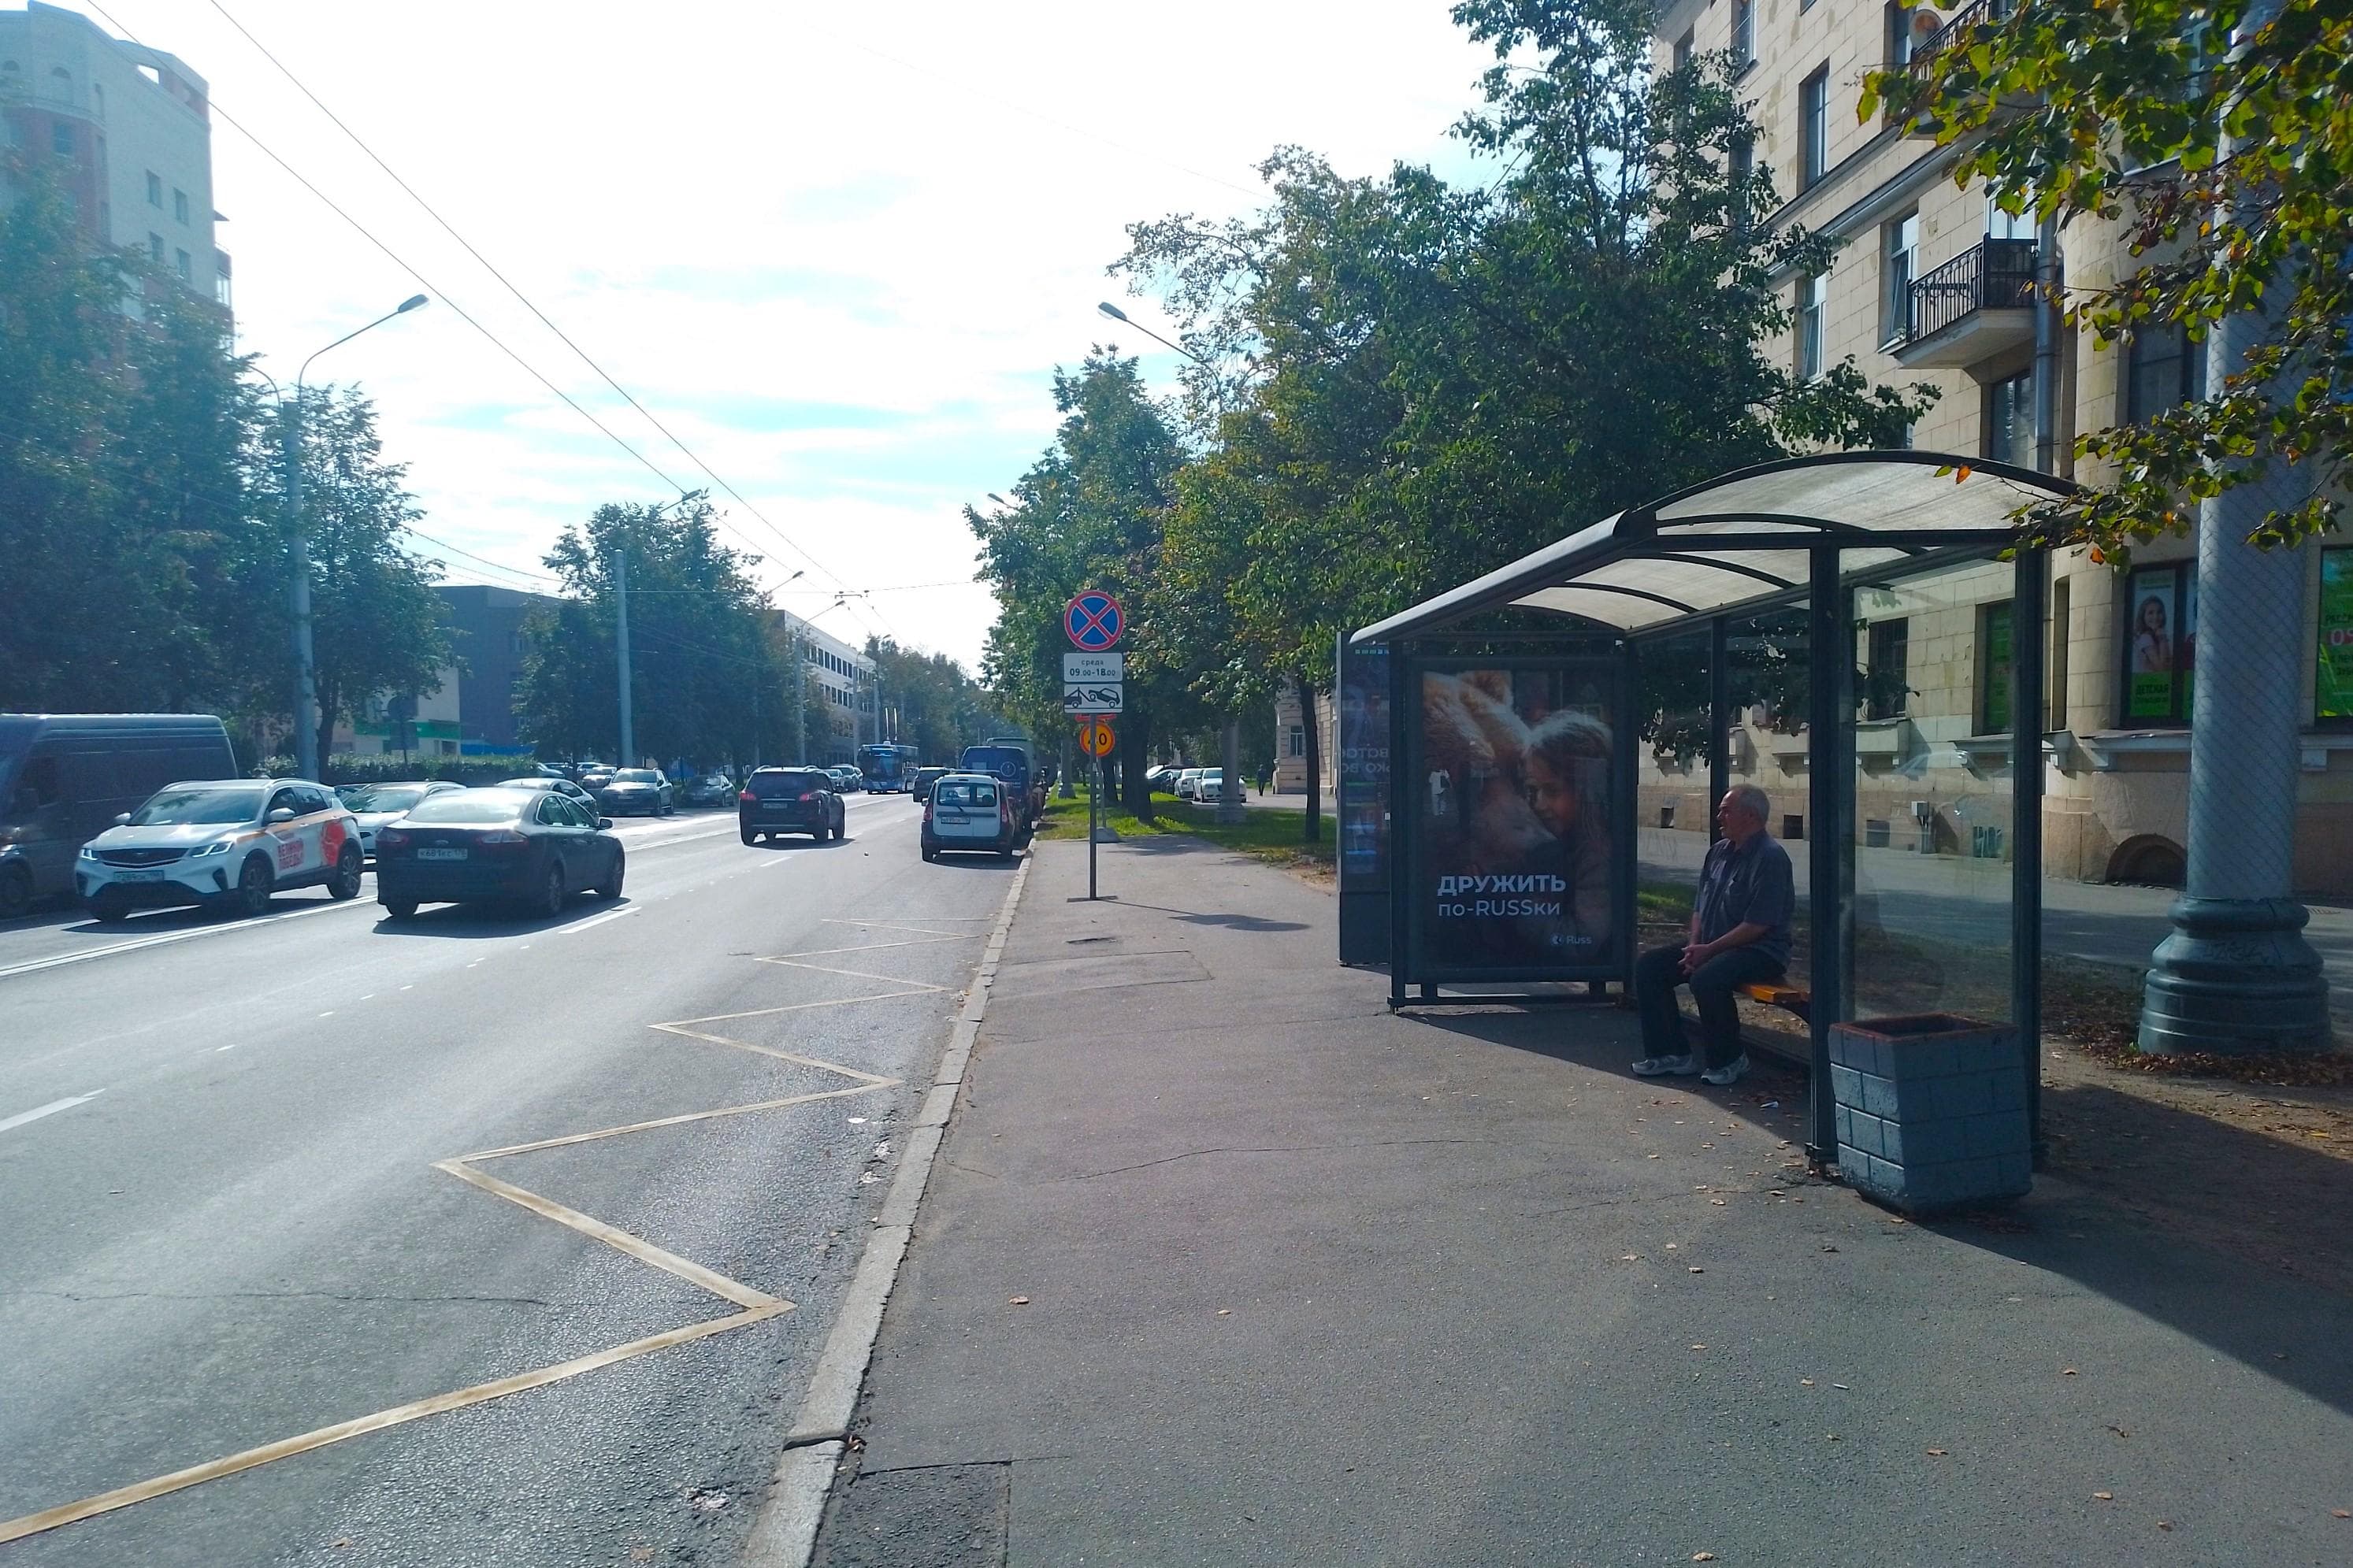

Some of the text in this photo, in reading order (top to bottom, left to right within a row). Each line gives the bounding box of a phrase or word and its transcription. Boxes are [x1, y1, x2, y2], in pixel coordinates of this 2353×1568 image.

[1437, 875, 1566, 896] ДРУЖИТЬ
[1438, 899, 1561, 917] по-RUSSки
[1567, 935, 1592, 944] Russ
